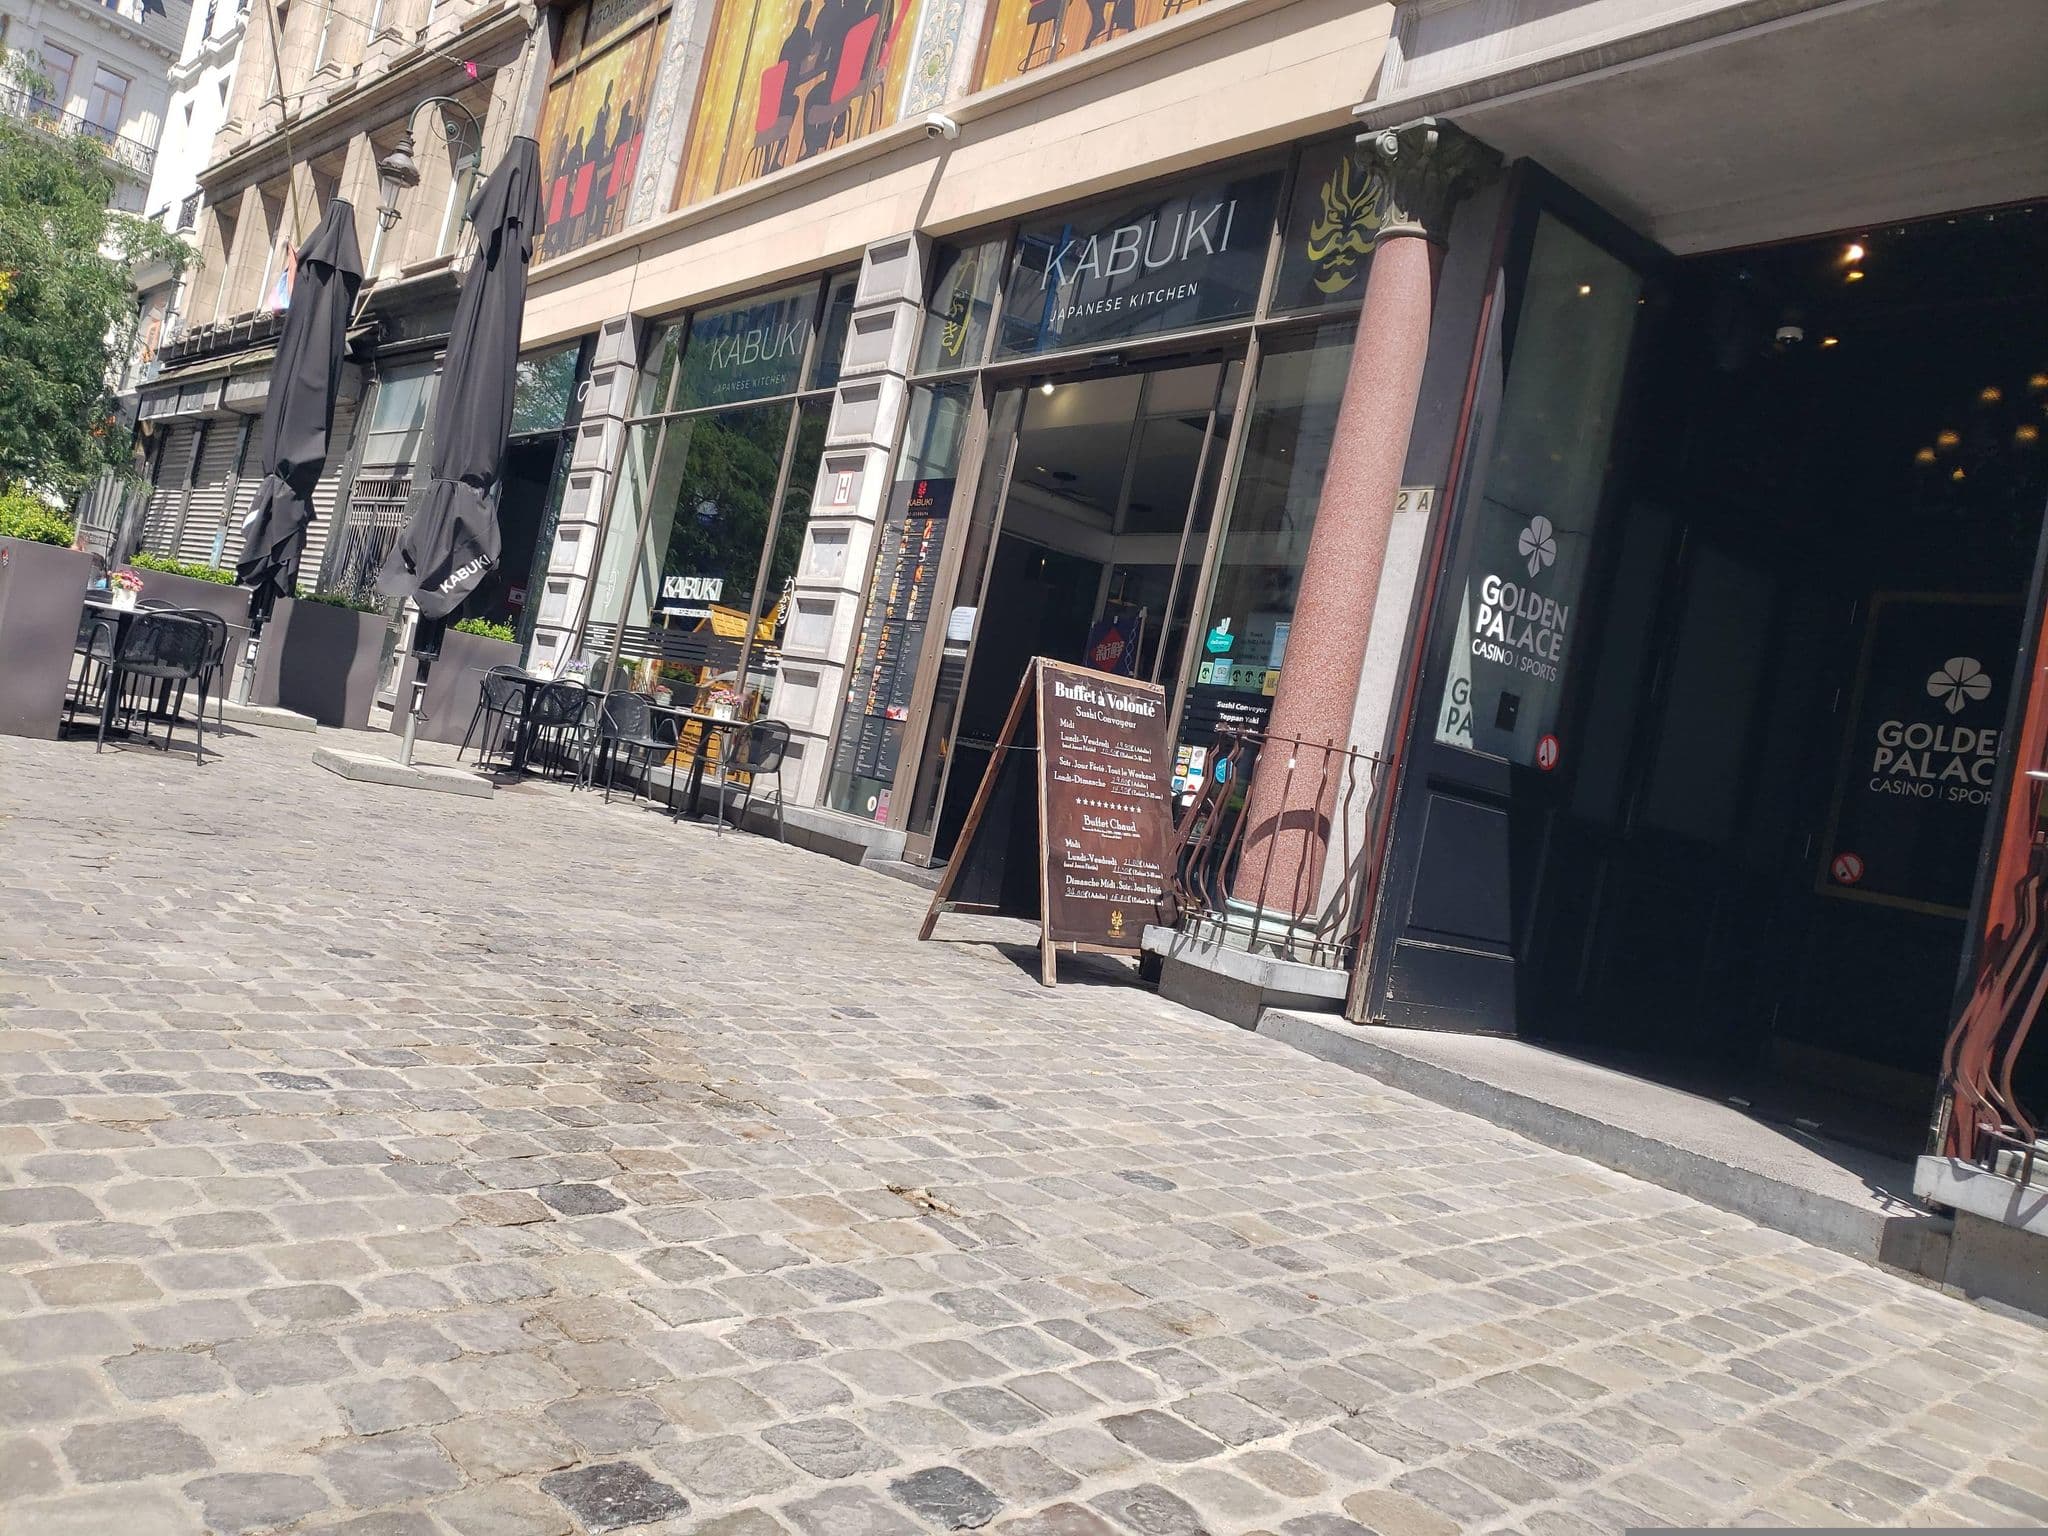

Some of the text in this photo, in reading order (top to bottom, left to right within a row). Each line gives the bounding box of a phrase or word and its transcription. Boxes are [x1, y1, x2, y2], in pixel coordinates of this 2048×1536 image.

[1040, 200, 1238, 291] KABUKI
[1050, 282, 1199, 322] JAPANESE KITCHEN
[709, 319, 808, 370] KABUKI
[712, 374, 786, 394] JAPANESE KITCHEN
[1418, 492, 1428, 510] A
[440, 554, 491, 593] KABUKI
[662, 576, 724, 601] KABUKI
[1482, 575, 1568, 632] GOLDEN
[1475, 604, 1564, 662] PALACE
[1472, 639, 1557, 682] CASINO SPORTS
[1054, 681, 1156, 717] Buffet à Volonté
[1216, 700, 1268, 714] Sushi Conveyor
[1060, 718, 1074, 728] Midi
[1076, 706, 1136, 729] Sushi Convoyeur
[1220, 712, 1244, 722] Teppan
[1128, 768, 1156, 781] Weekend
[1870, 778, 1934, 798] CASINO
[1084, 814, 1108, 828] Buffet
[1110, 818, 1136, 832] Chaud
[1066, 874, 1099, 887] Dimanche
